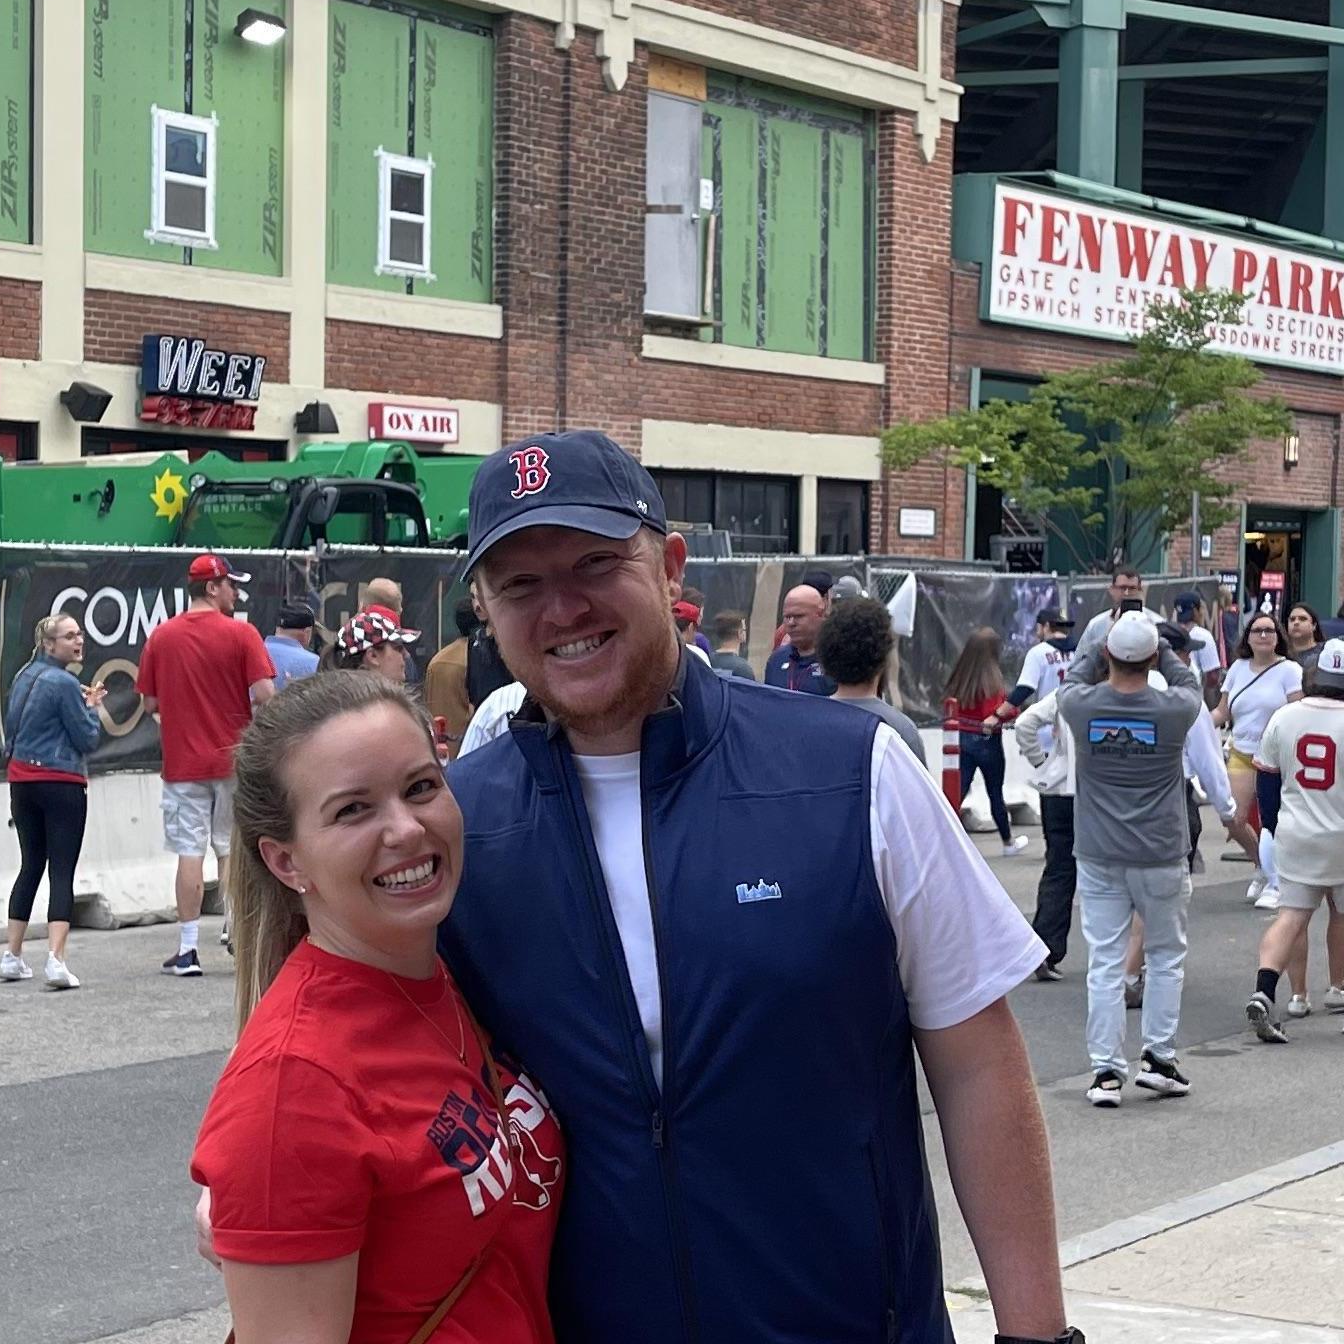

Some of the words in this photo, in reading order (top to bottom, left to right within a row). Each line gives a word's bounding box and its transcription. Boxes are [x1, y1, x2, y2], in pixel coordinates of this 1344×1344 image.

[1000, 197, 1218, 292] FENWAY
[1000, 264, 1053, 291] GATE
[1069, 277, 1080, 295] C
[998, 288, 1081, 319] IPSWICH
[1291, 341, 1343, 362] STREET
[1266, 313, 1344, 343] SECTIONS
[388, 411, 414, 432] ON
[419, 414, 453, 434] AIR
[509, 445, 552, 499] B
[1295, 734, 1337, 791] 9
